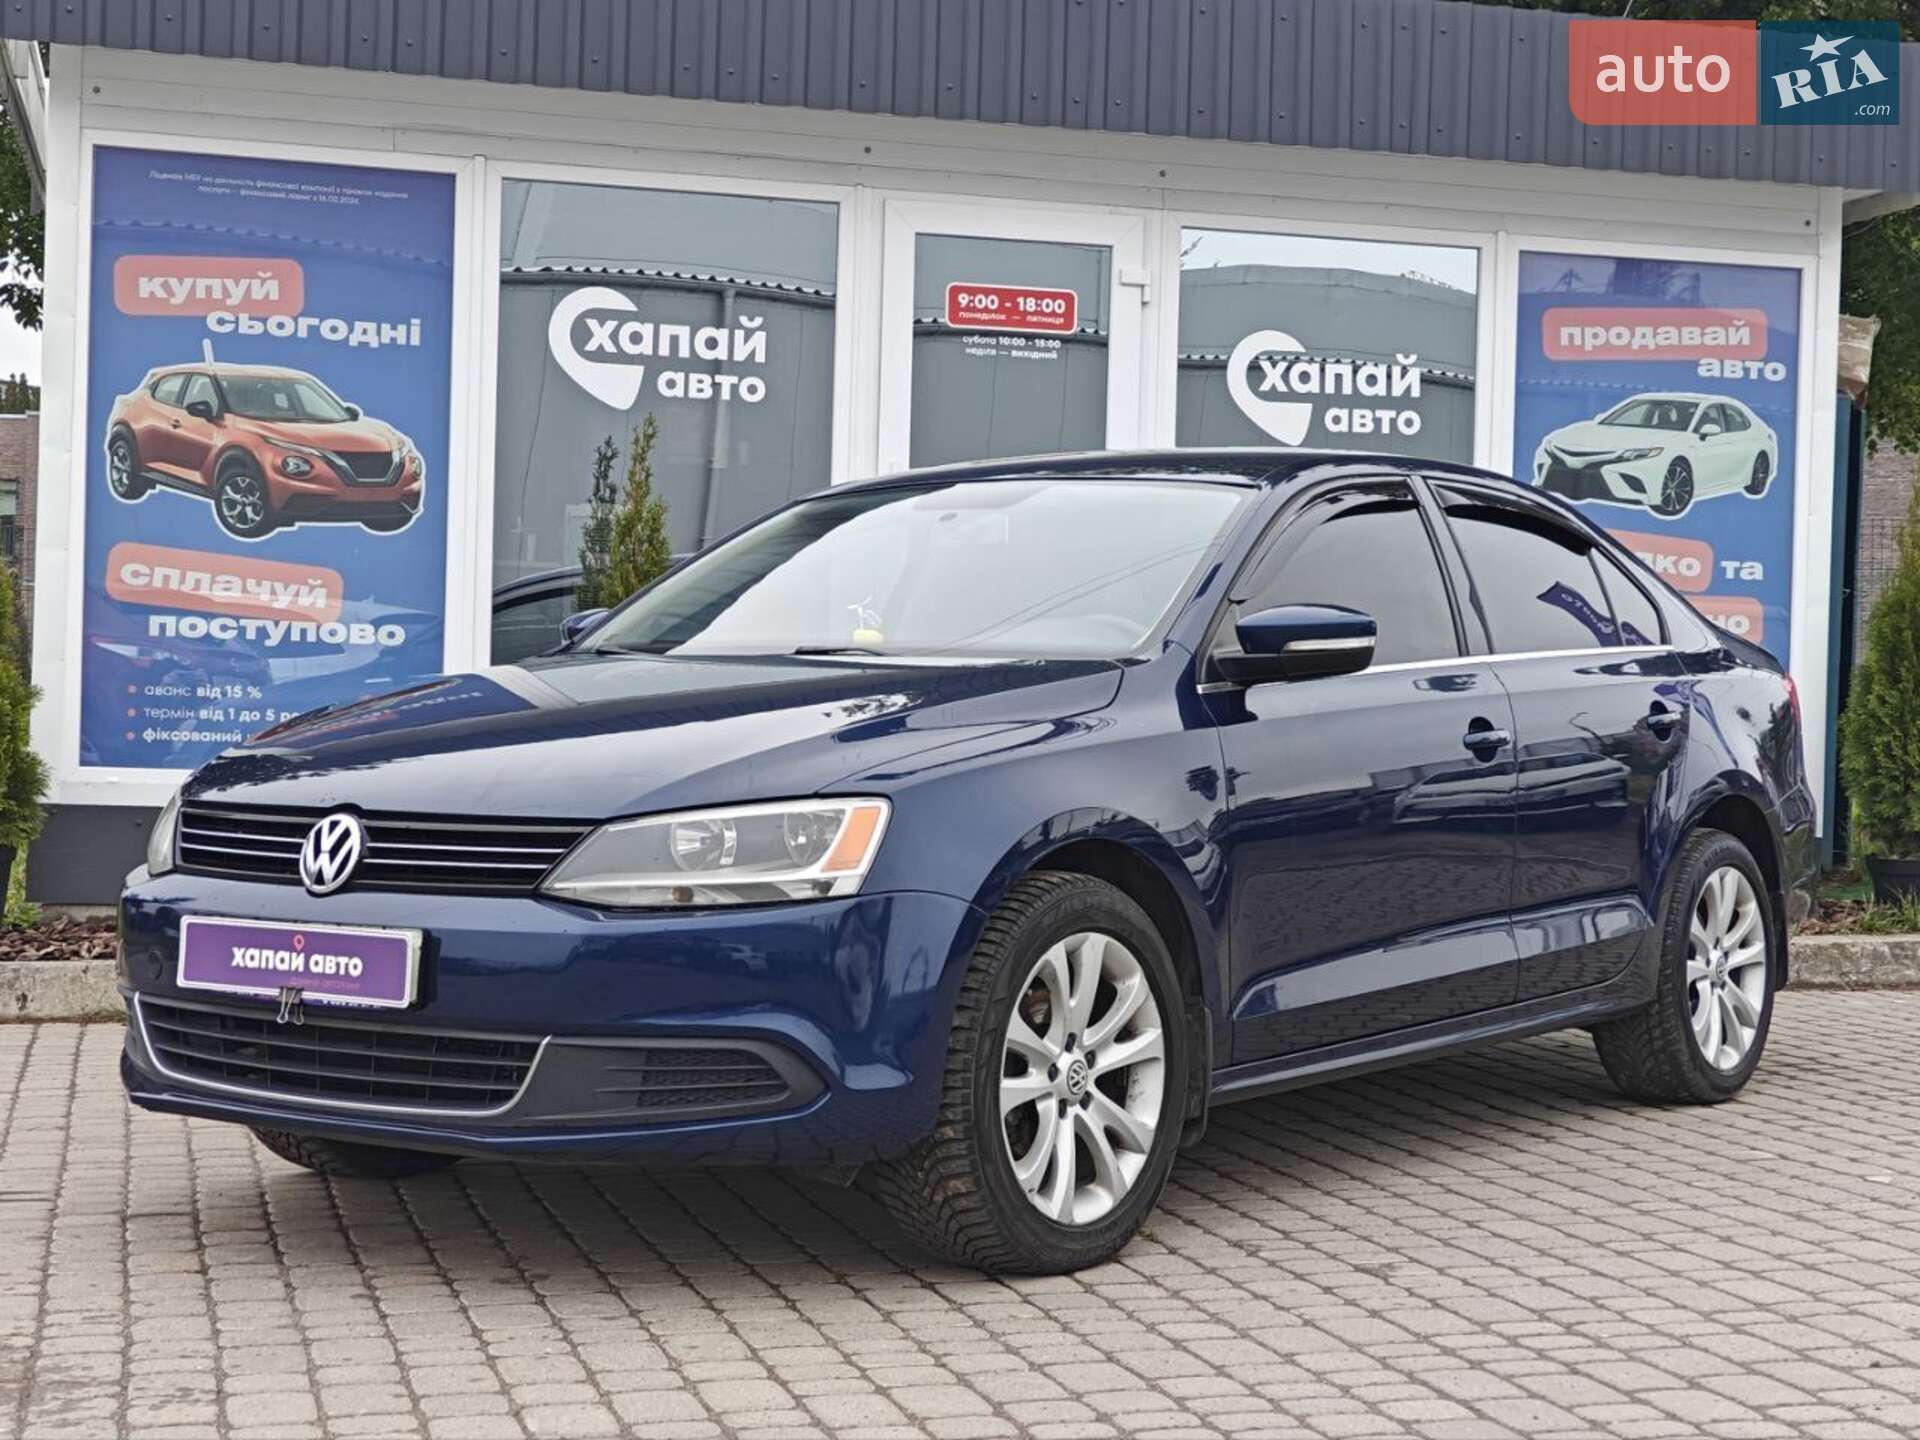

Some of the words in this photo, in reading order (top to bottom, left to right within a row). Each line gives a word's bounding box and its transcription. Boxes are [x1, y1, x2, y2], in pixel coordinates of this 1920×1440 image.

[138, 271, 279, 305] купуй
[958, 293, 999, 310] 9:00
[1017, 296, 1066, 314] 18:00
[206, 310, 422, 348] сьогодні
[583, 315, 767, 364] хапай
[1560, 319, 1750, 351] продавай
[1258, 353, 1422, 398] хапай
[1697, 358, 1787, 382] авто
[656, 370, 766, 403] авто
[1324, 407, 1422, 436] авто
[120, 563, 328, 609] сплачуй
[1721, 561, 1764, 580] та
[149, 615, 406, 647] поступово
[144, 685, 192, 697] аванс
[196, 684, 222, 700] від
[225, 685, 242, 698] 15
[144, 706, 194, 719] термін
[199, 707, 224, 722] від
[228, 708, 234, 720] 1
[239, 710, 260, 723] до
[266, 708, 275, 721] 5
[142, 727, 242, 743] фіксований
[231, 940, 305, 972] хапай
[309, 954, 364, 977] авто
